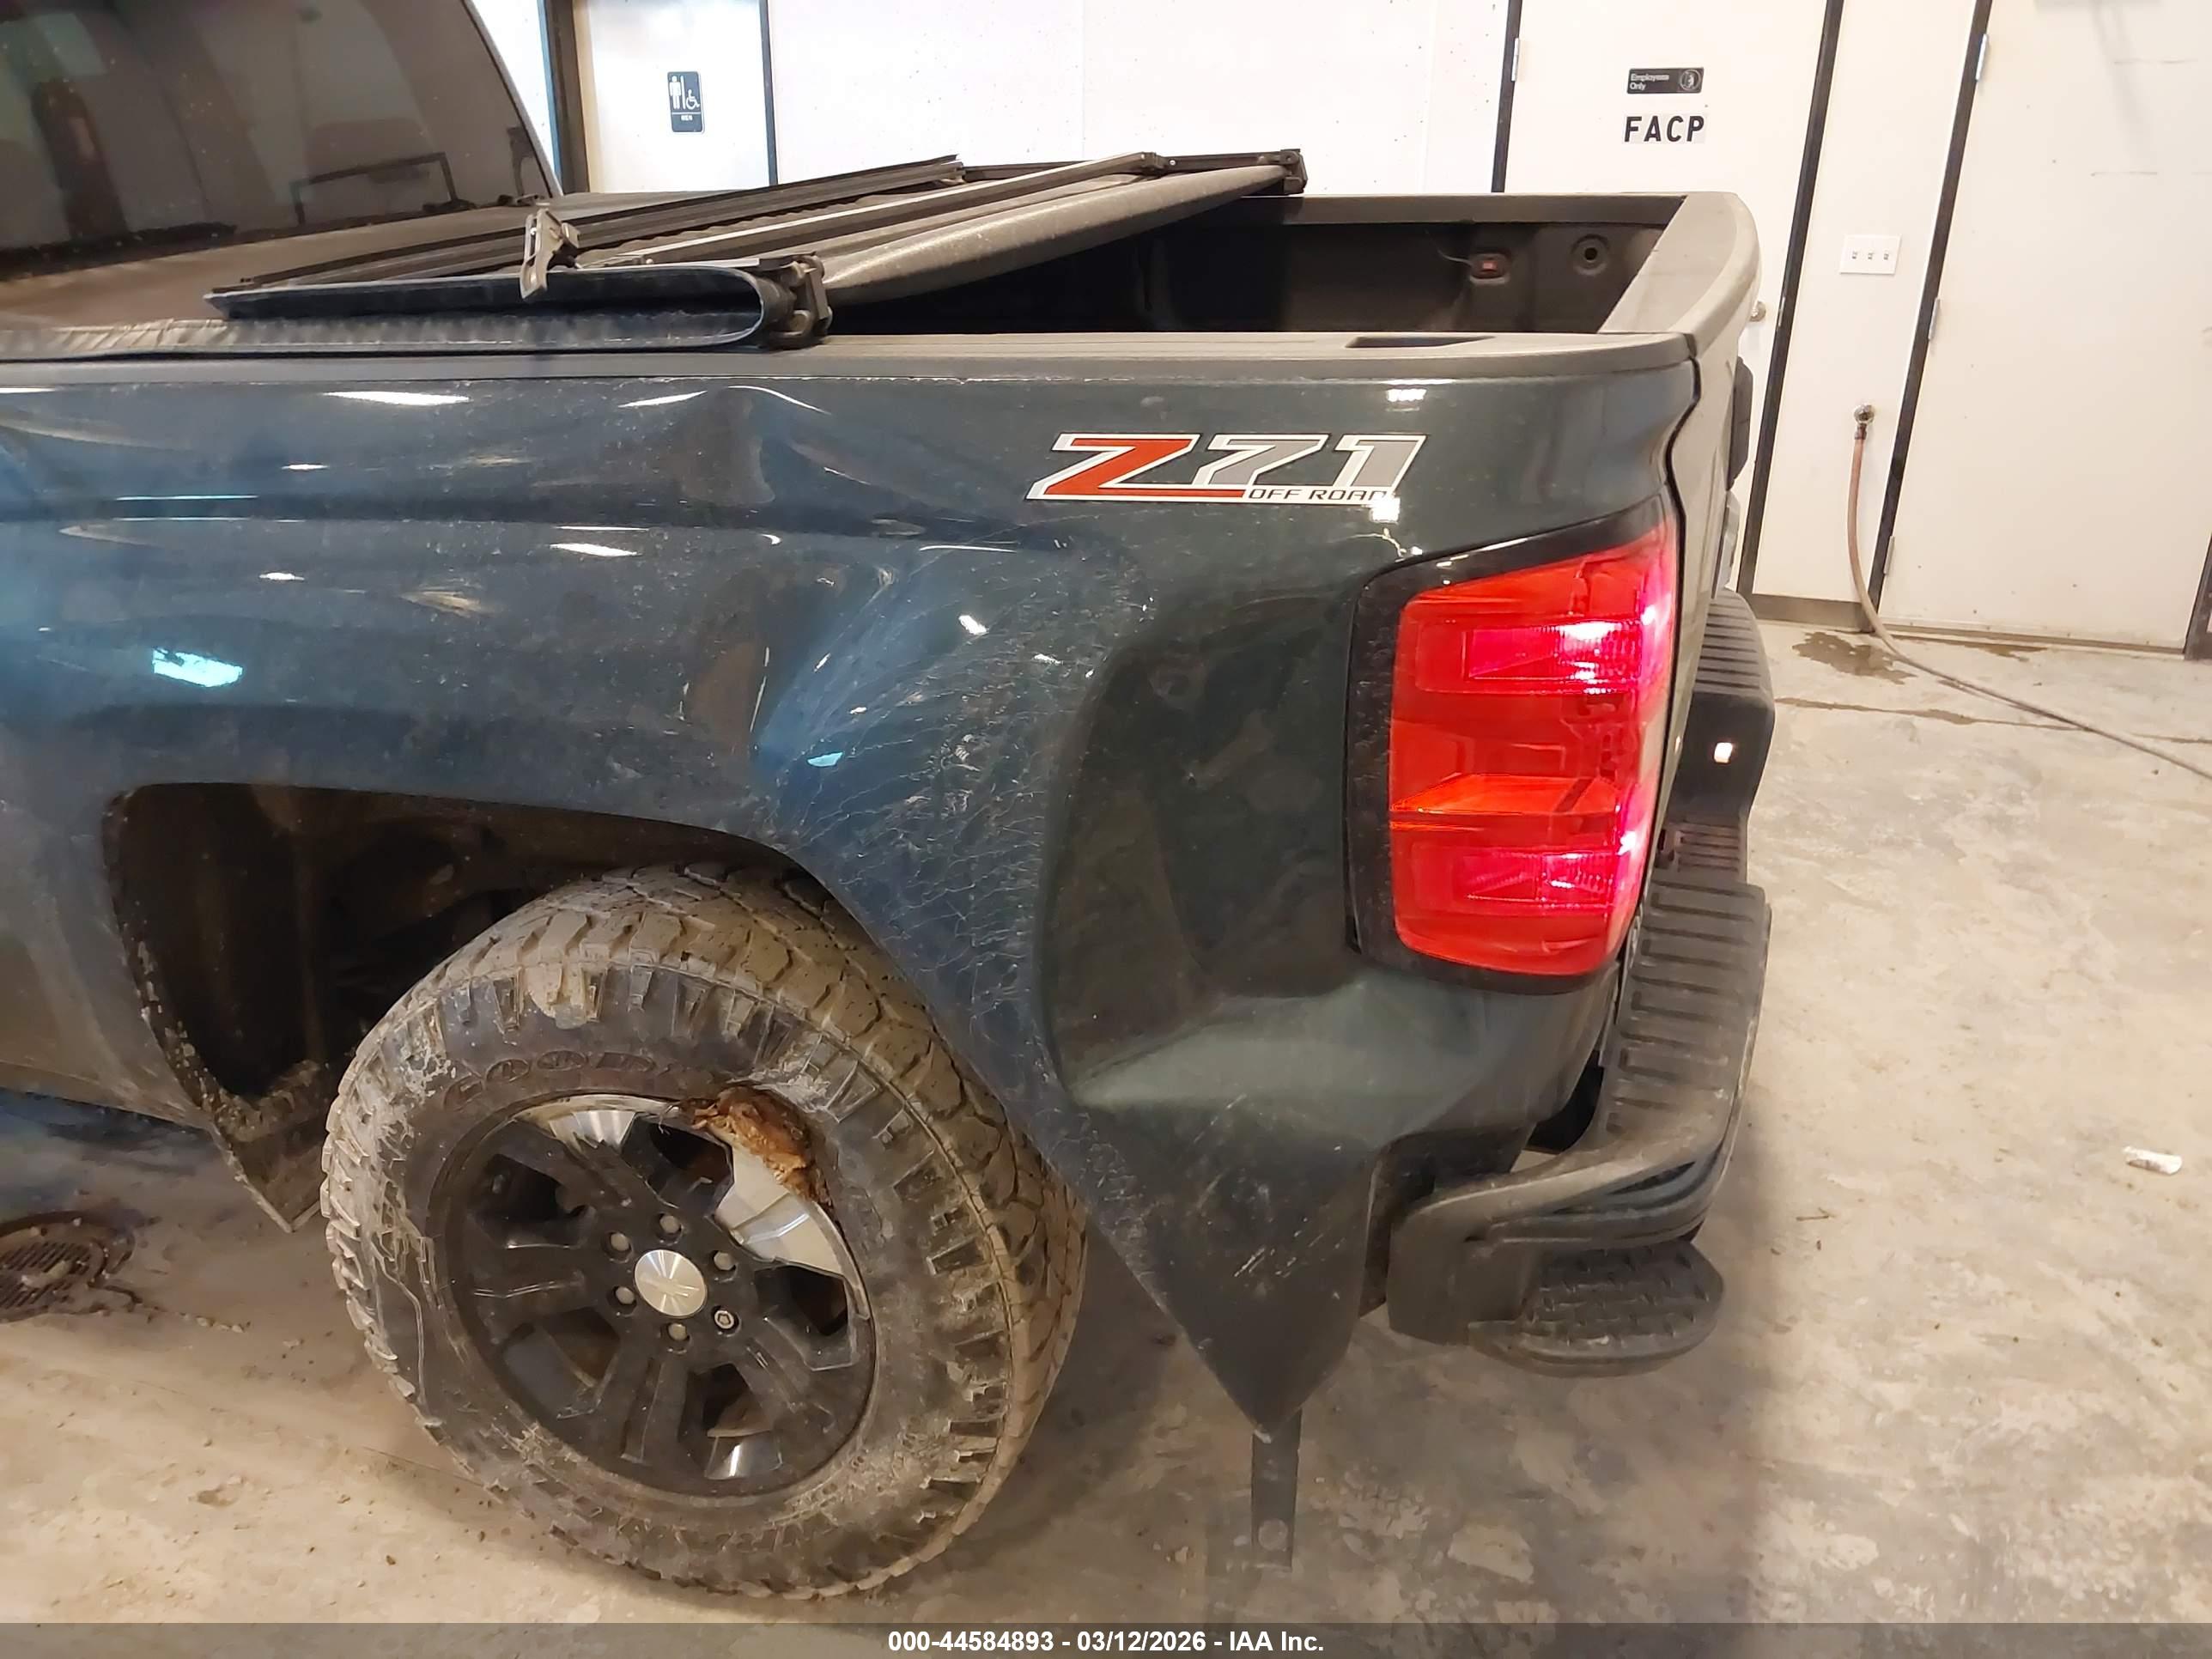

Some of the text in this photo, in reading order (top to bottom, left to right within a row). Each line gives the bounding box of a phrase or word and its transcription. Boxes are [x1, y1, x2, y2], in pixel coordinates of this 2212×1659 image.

[1629, 82, 1647, 91] Only
[1624, 115, 1705, 142] FACP
[1025, 433, 1427, 505] Z71
[1249, 489, 1303, 500] OFF
